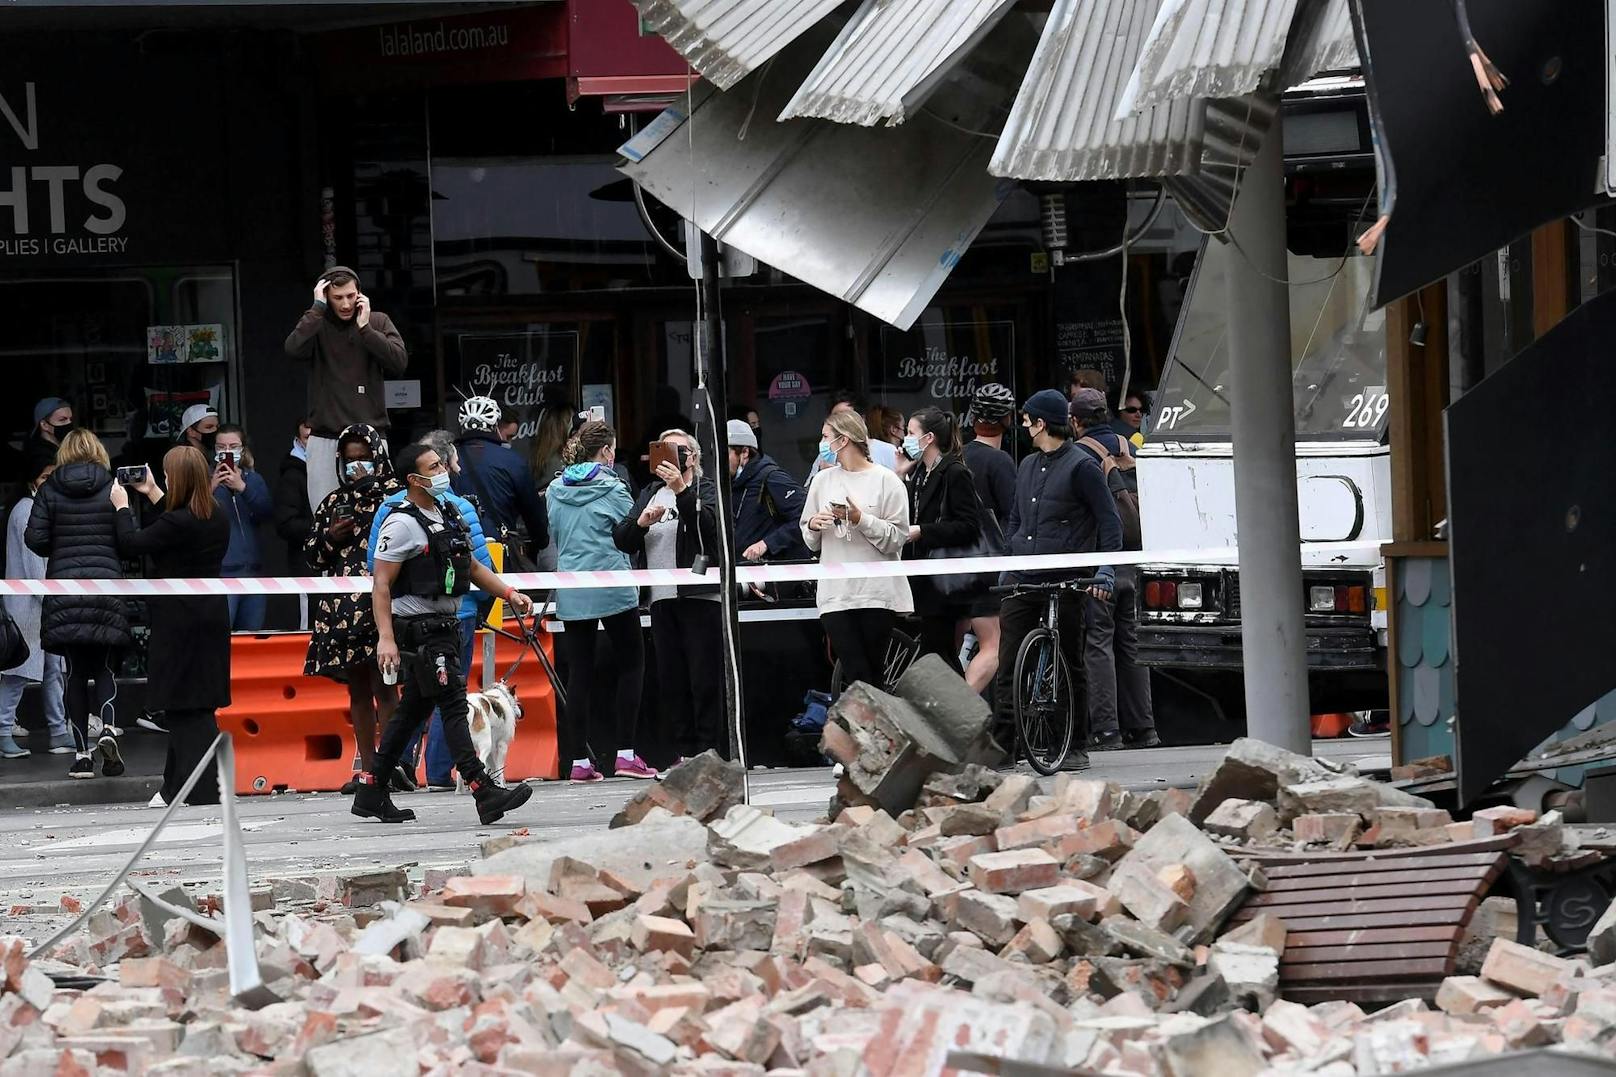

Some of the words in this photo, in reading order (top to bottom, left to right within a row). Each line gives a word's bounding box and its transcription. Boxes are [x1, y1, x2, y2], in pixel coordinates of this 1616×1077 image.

[379, 21, 508, 57] lalaland.com.au
[53, 237, 128, 254] GALLERY
[494, 353, 519, 369] The
[920, 346, 946, 361] The
[474, 363, 566, 390] Breakfast
[897, 356, 999, 382] Breakfast
[504, 385, 546, 406] Club
[930, 377, 976, 398] Club
[1342, 393, 1390, 428] 269
